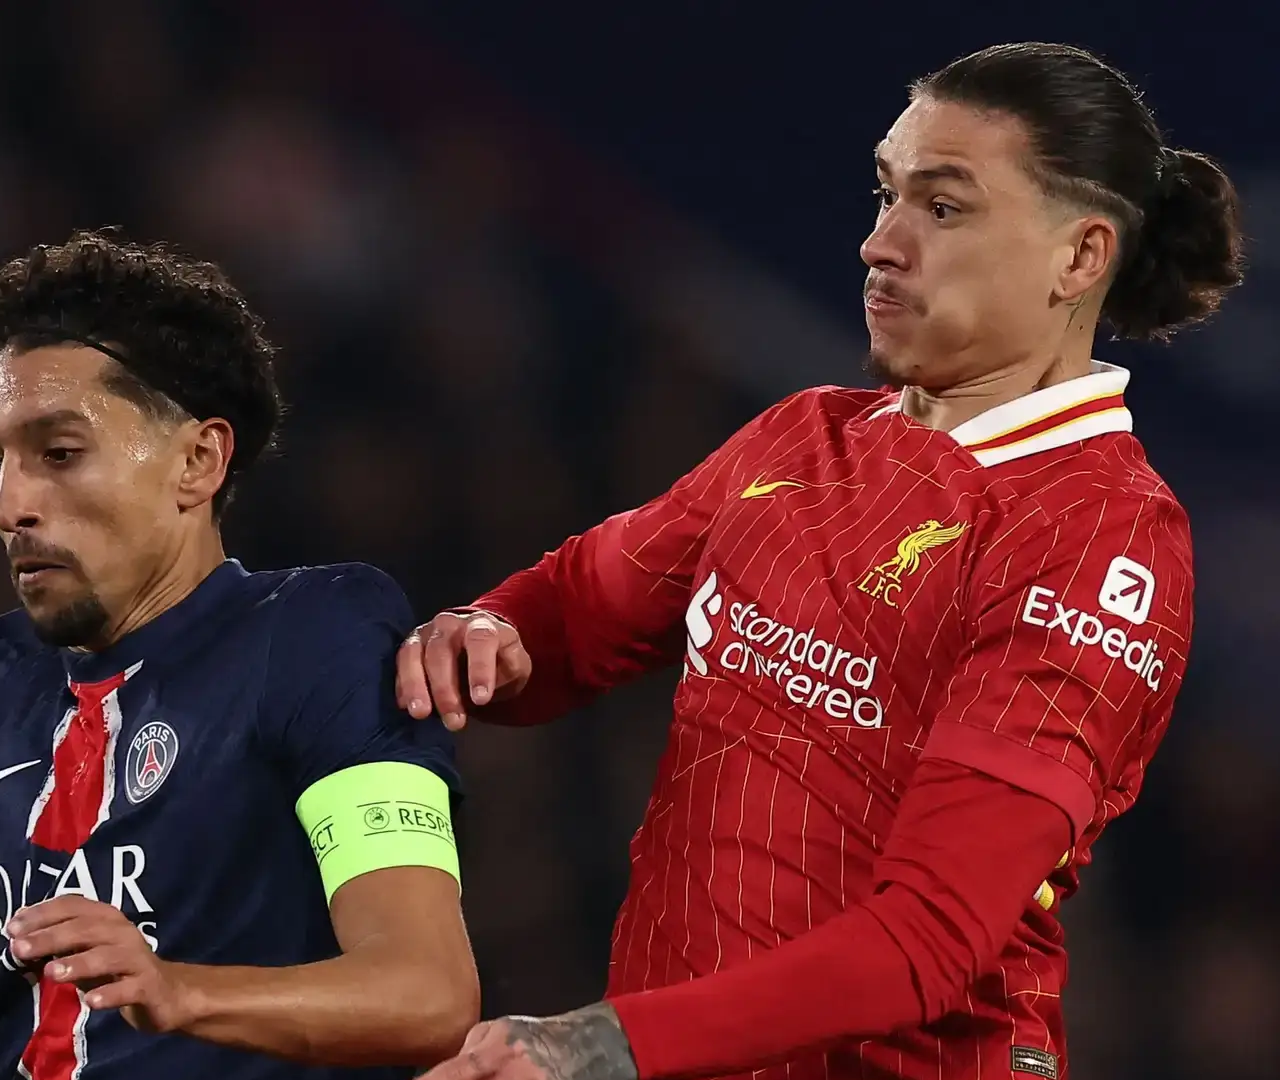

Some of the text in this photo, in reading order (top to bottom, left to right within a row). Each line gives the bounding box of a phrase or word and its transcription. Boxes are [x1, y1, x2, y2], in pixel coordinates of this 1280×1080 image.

[729, 602, 878, 690] standard
[1022, 585, 1165, 692] Expedia
[134, 725, 170, 751] PARIS
